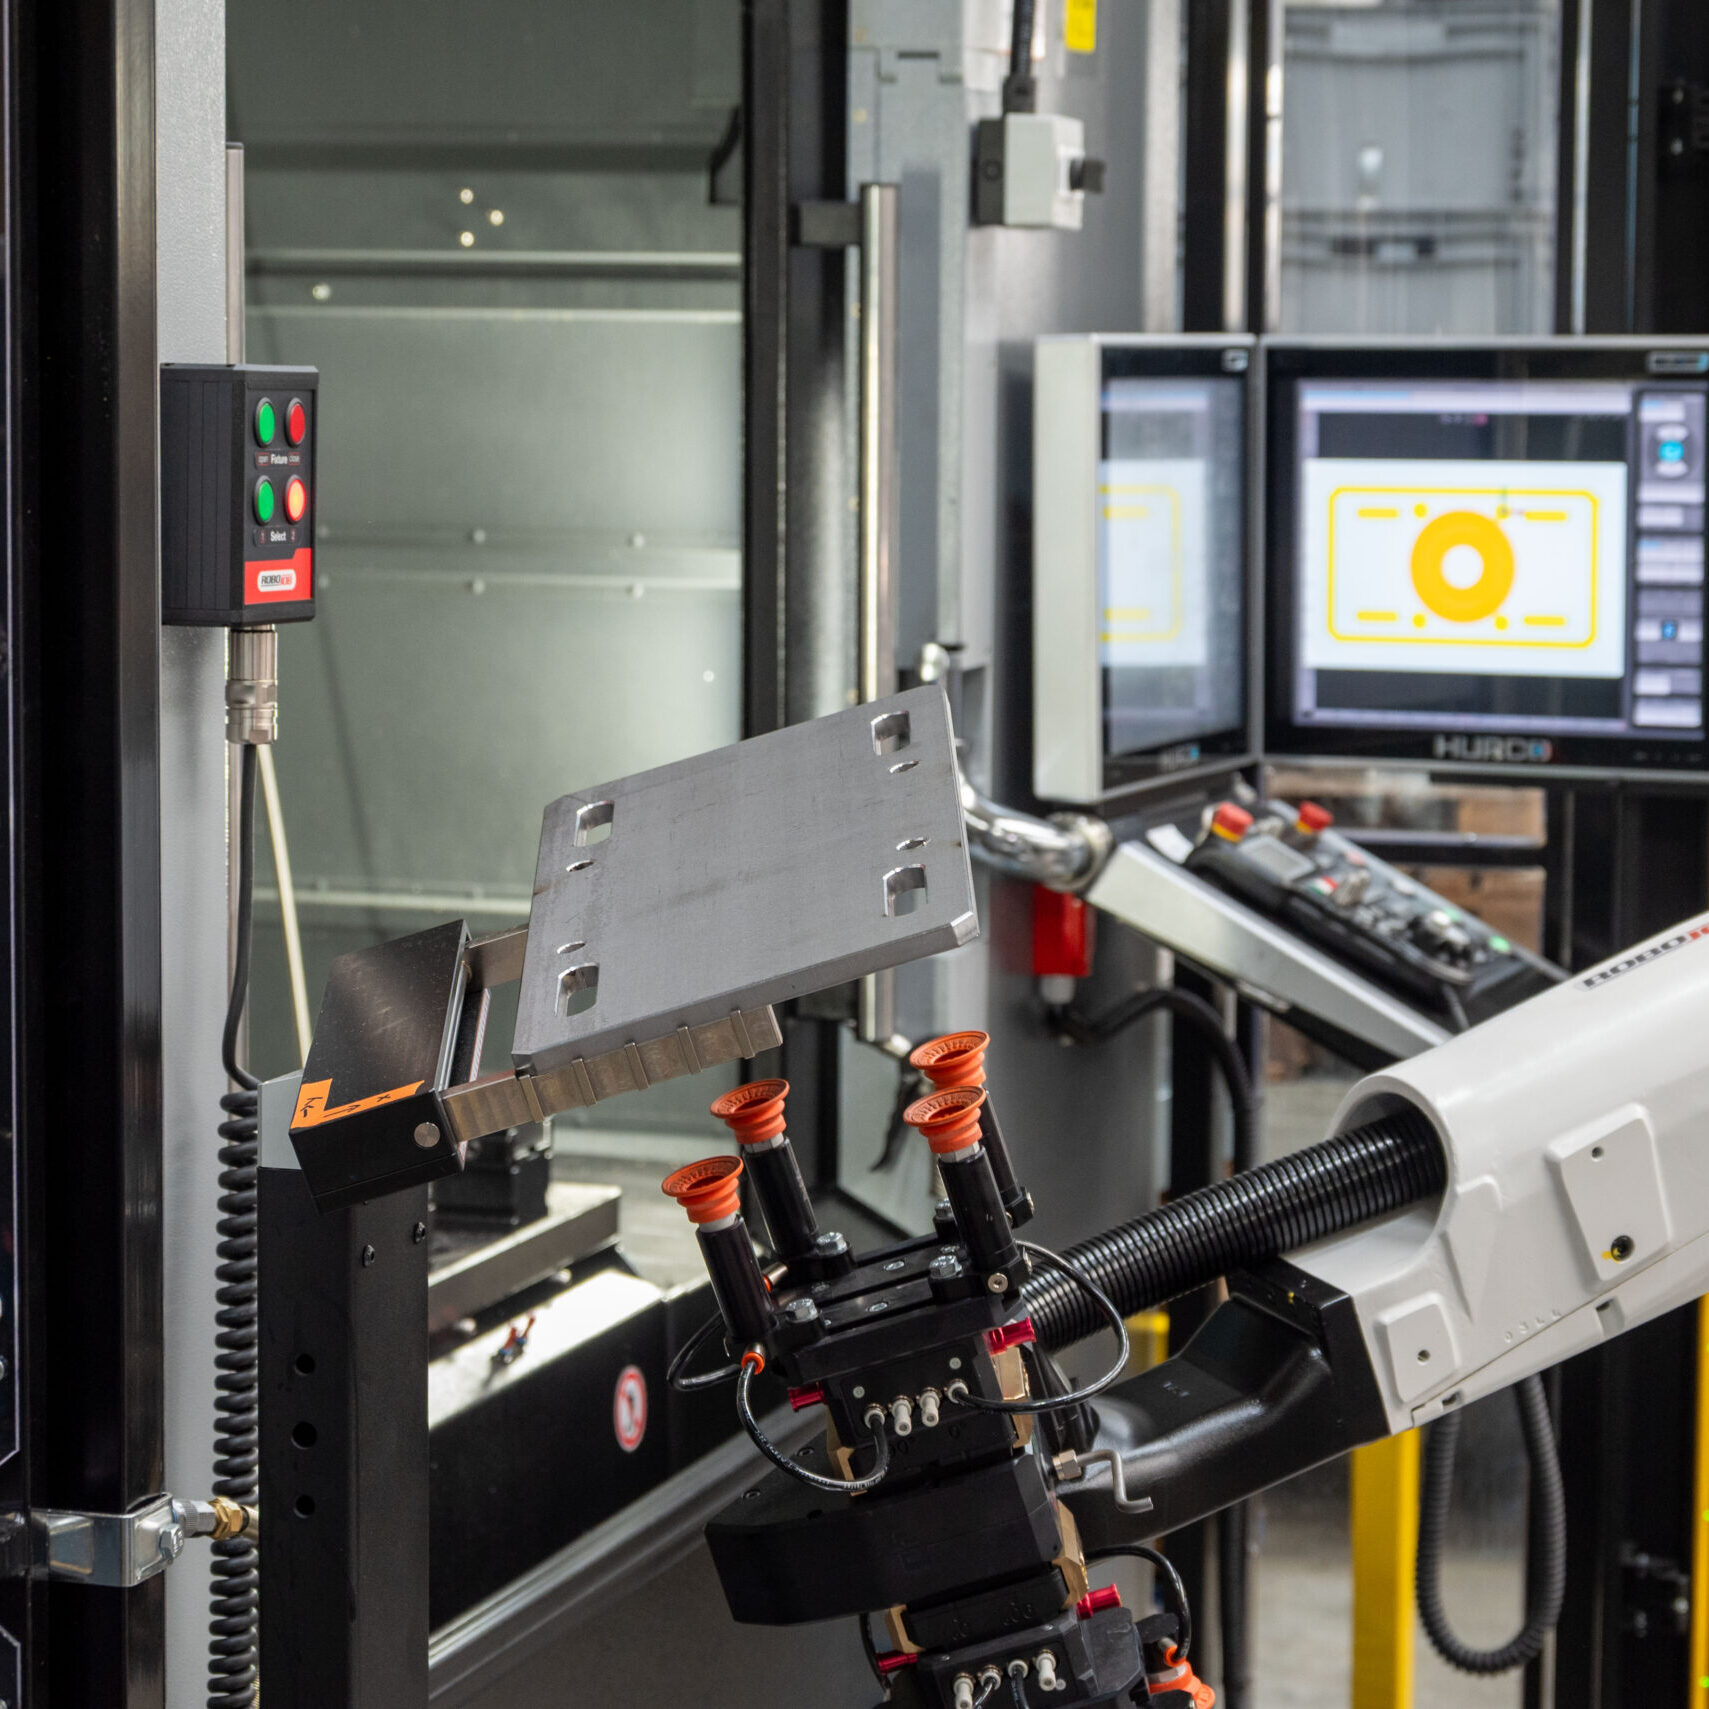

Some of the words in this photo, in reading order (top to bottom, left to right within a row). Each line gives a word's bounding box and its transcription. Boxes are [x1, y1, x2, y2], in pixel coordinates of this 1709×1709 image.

[270, 453, 288, 465] Fixture
[270, 531, 287, 542] Select
[1432, 735, 1553, 762] HURCO
